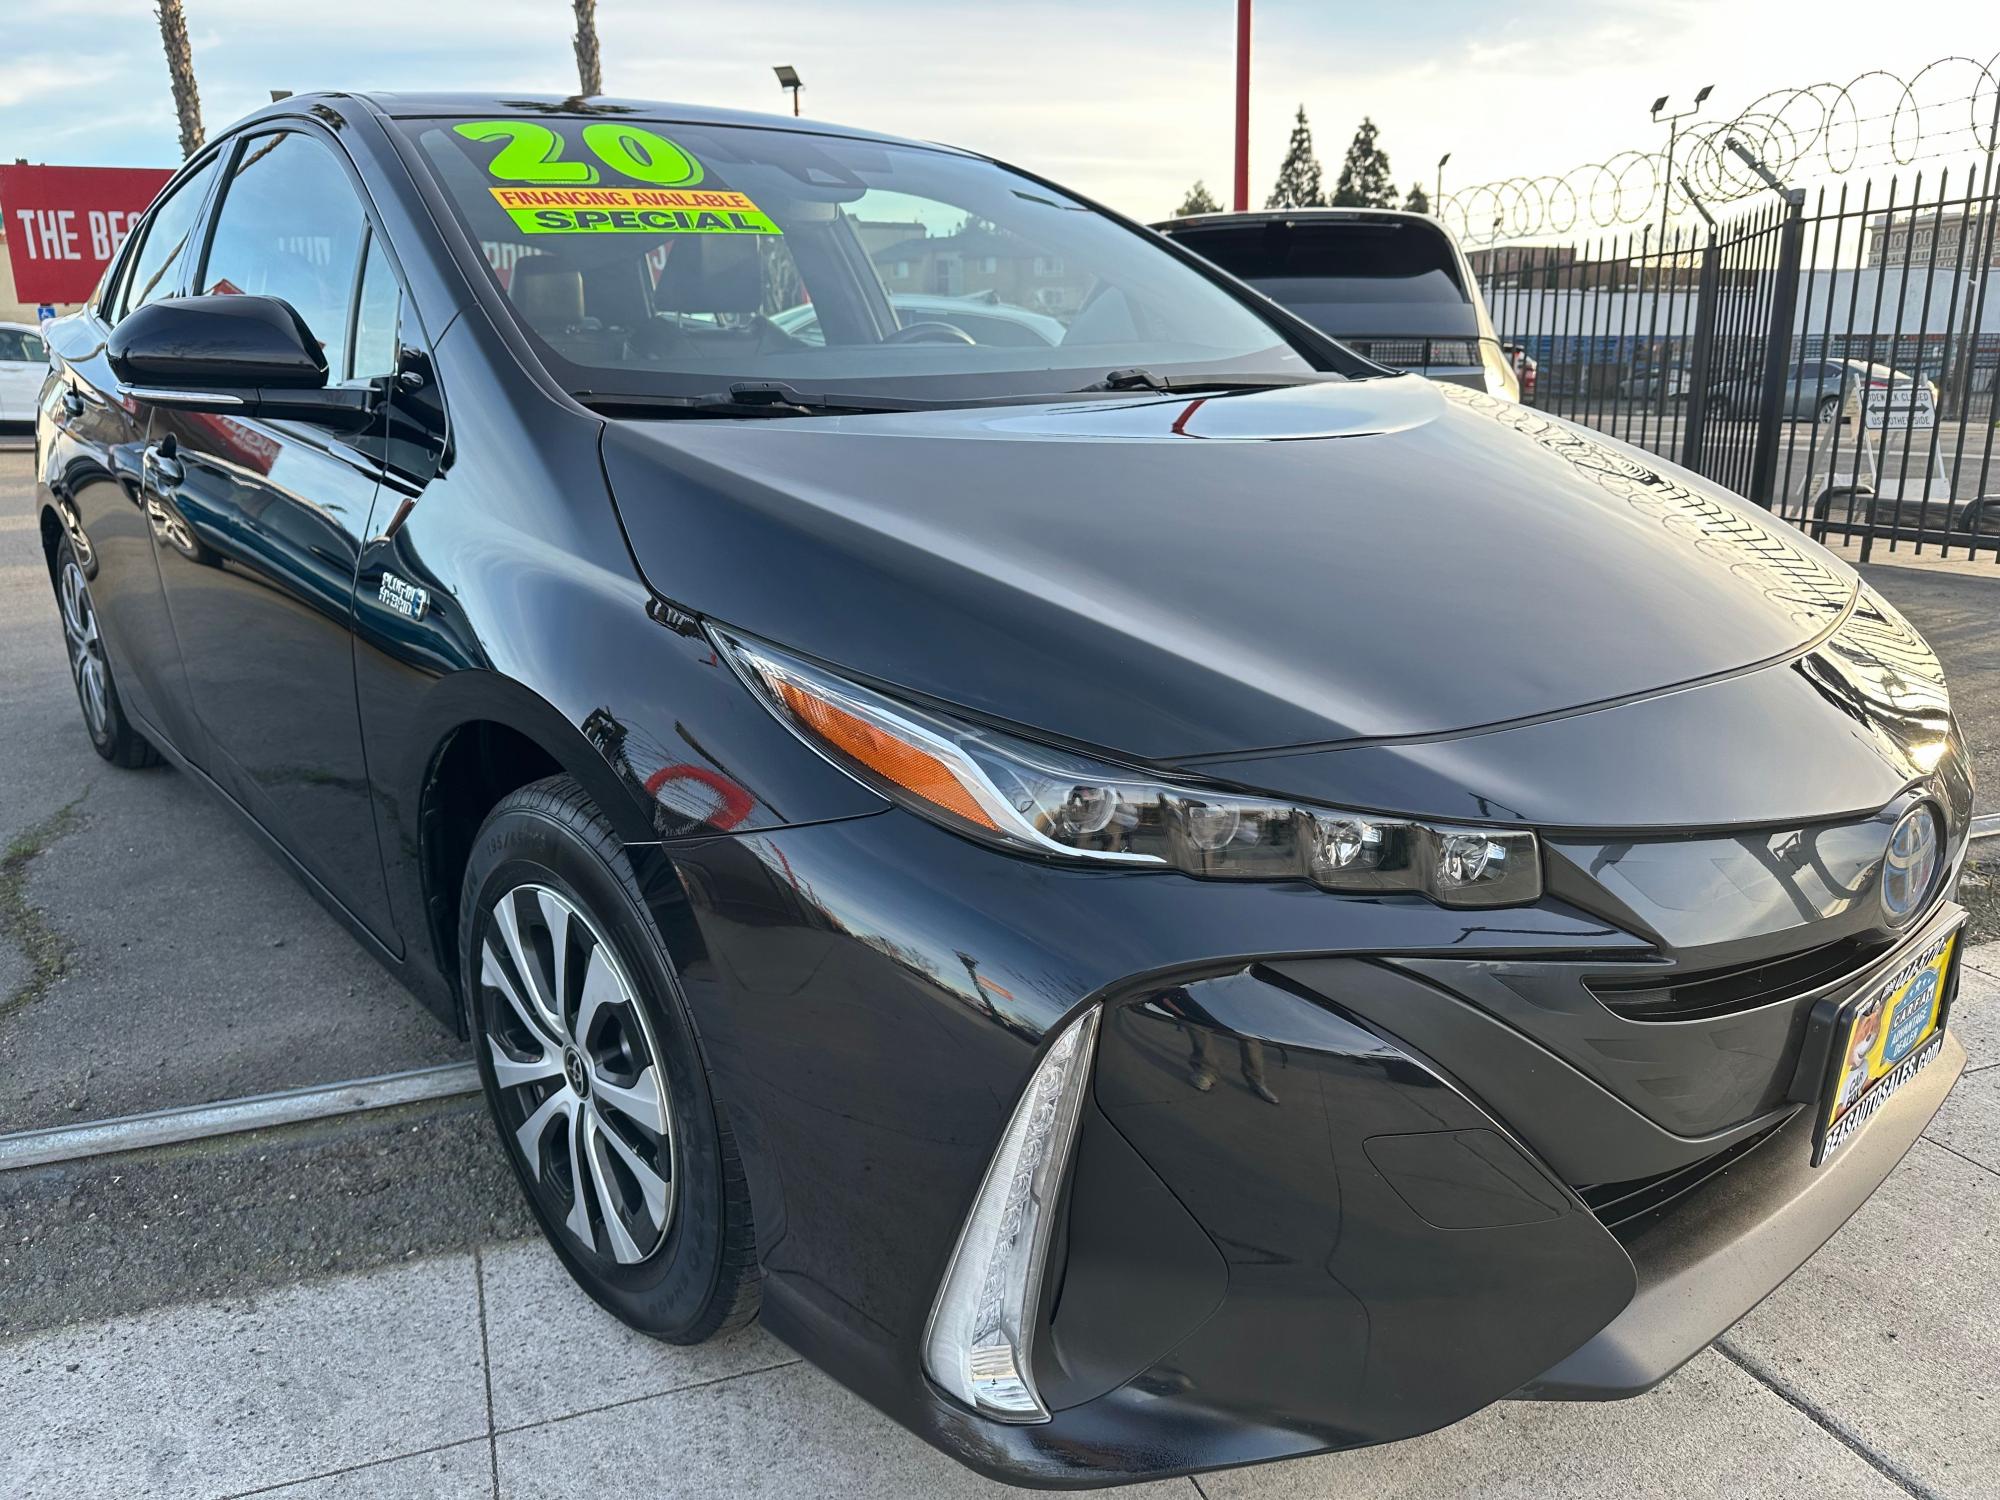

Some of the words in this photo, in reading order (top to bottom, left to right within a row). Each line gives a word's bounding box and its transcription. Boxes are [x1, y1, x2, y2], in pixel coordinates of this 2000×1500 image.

[453, 120, 704, 187] 20
[499, 190, 629, 206] FINANCING
[634, 193, 747, 209] AVAILABLE
[16, 209, 81, 260] THE
[534, 209, 767, 232] SPECIAL
[1893, 1027, 1919, 1057] DEALER
